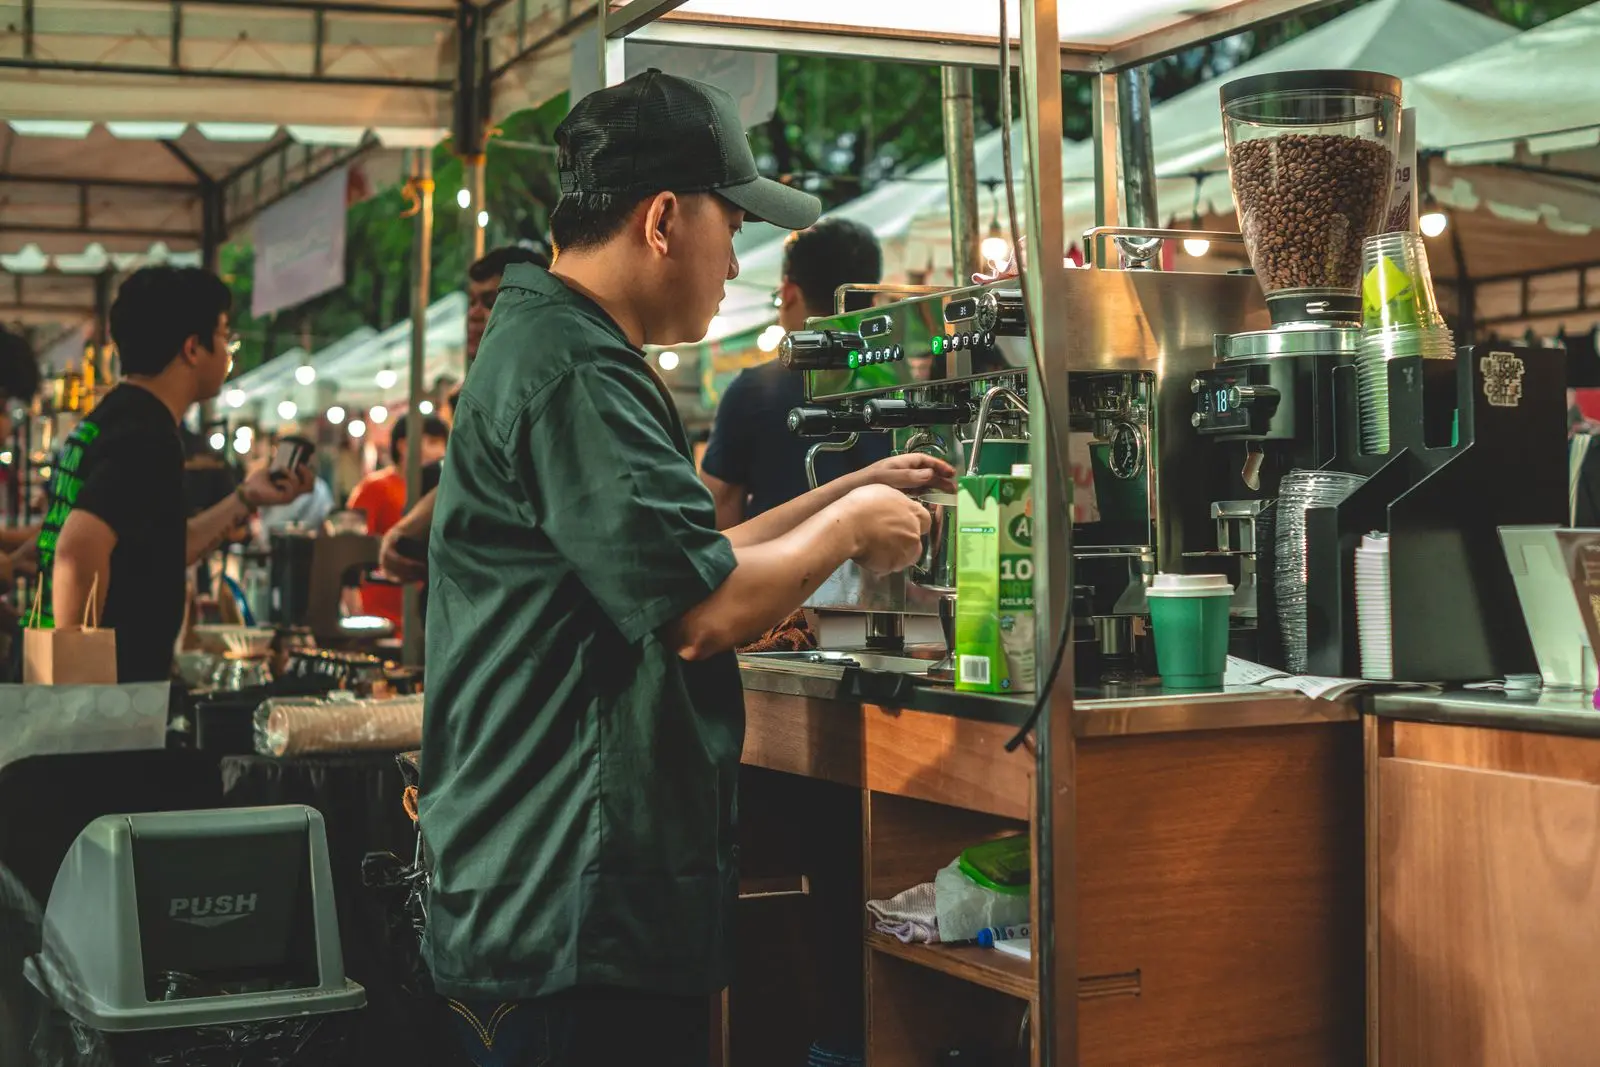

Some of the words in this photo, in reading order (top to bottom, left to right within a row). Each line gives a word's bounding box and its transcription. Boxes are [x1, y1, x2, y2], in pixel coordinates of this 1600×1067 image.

[1015, 517, 1034, 537] A
[1001, 598, 1023, 606] MILK
[169, 893, 258, 916] PUSH
